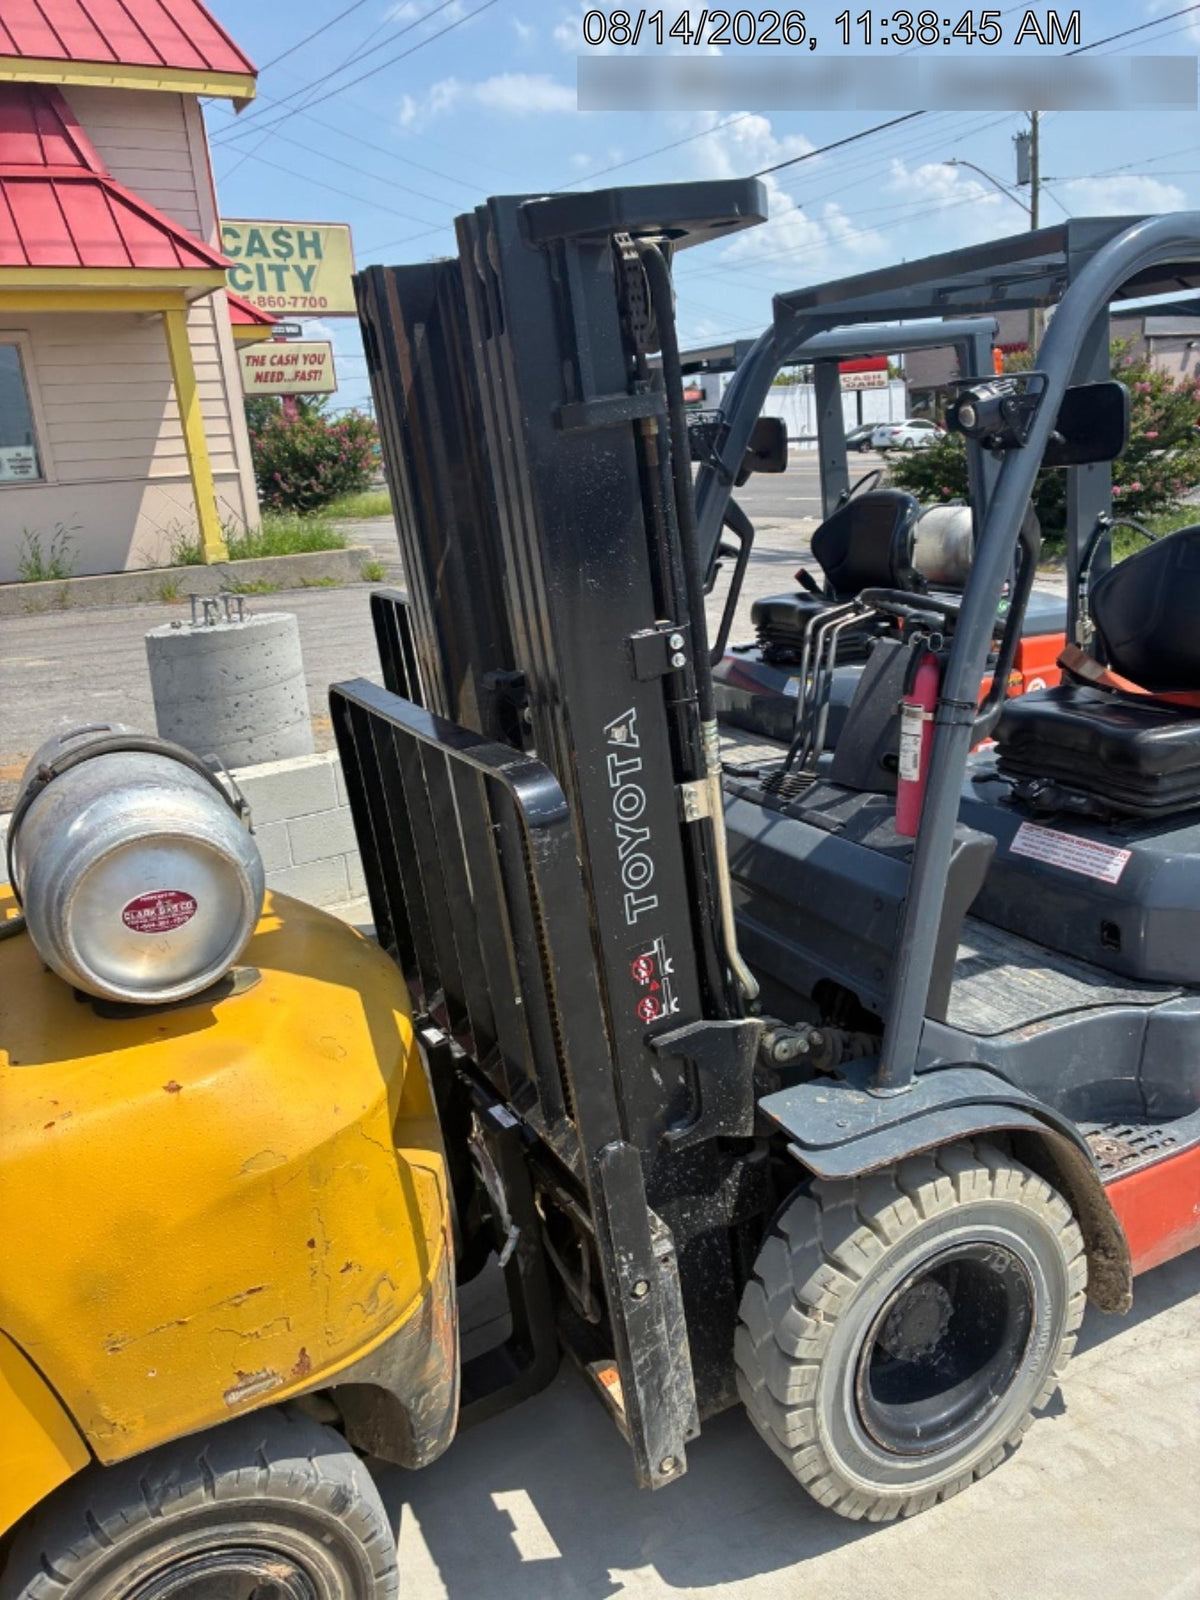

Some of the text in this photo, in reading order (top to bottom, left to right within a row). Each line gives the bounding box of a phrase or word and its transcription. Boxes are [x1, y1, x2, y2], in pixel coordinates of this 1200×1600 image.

[222, 226, 323, 262] CA$H
[227, 263, 317, 292] CITY
[245, 353, 326, 367] THE CASH YOU
[603, 706, 658, 925] TOYOTA
